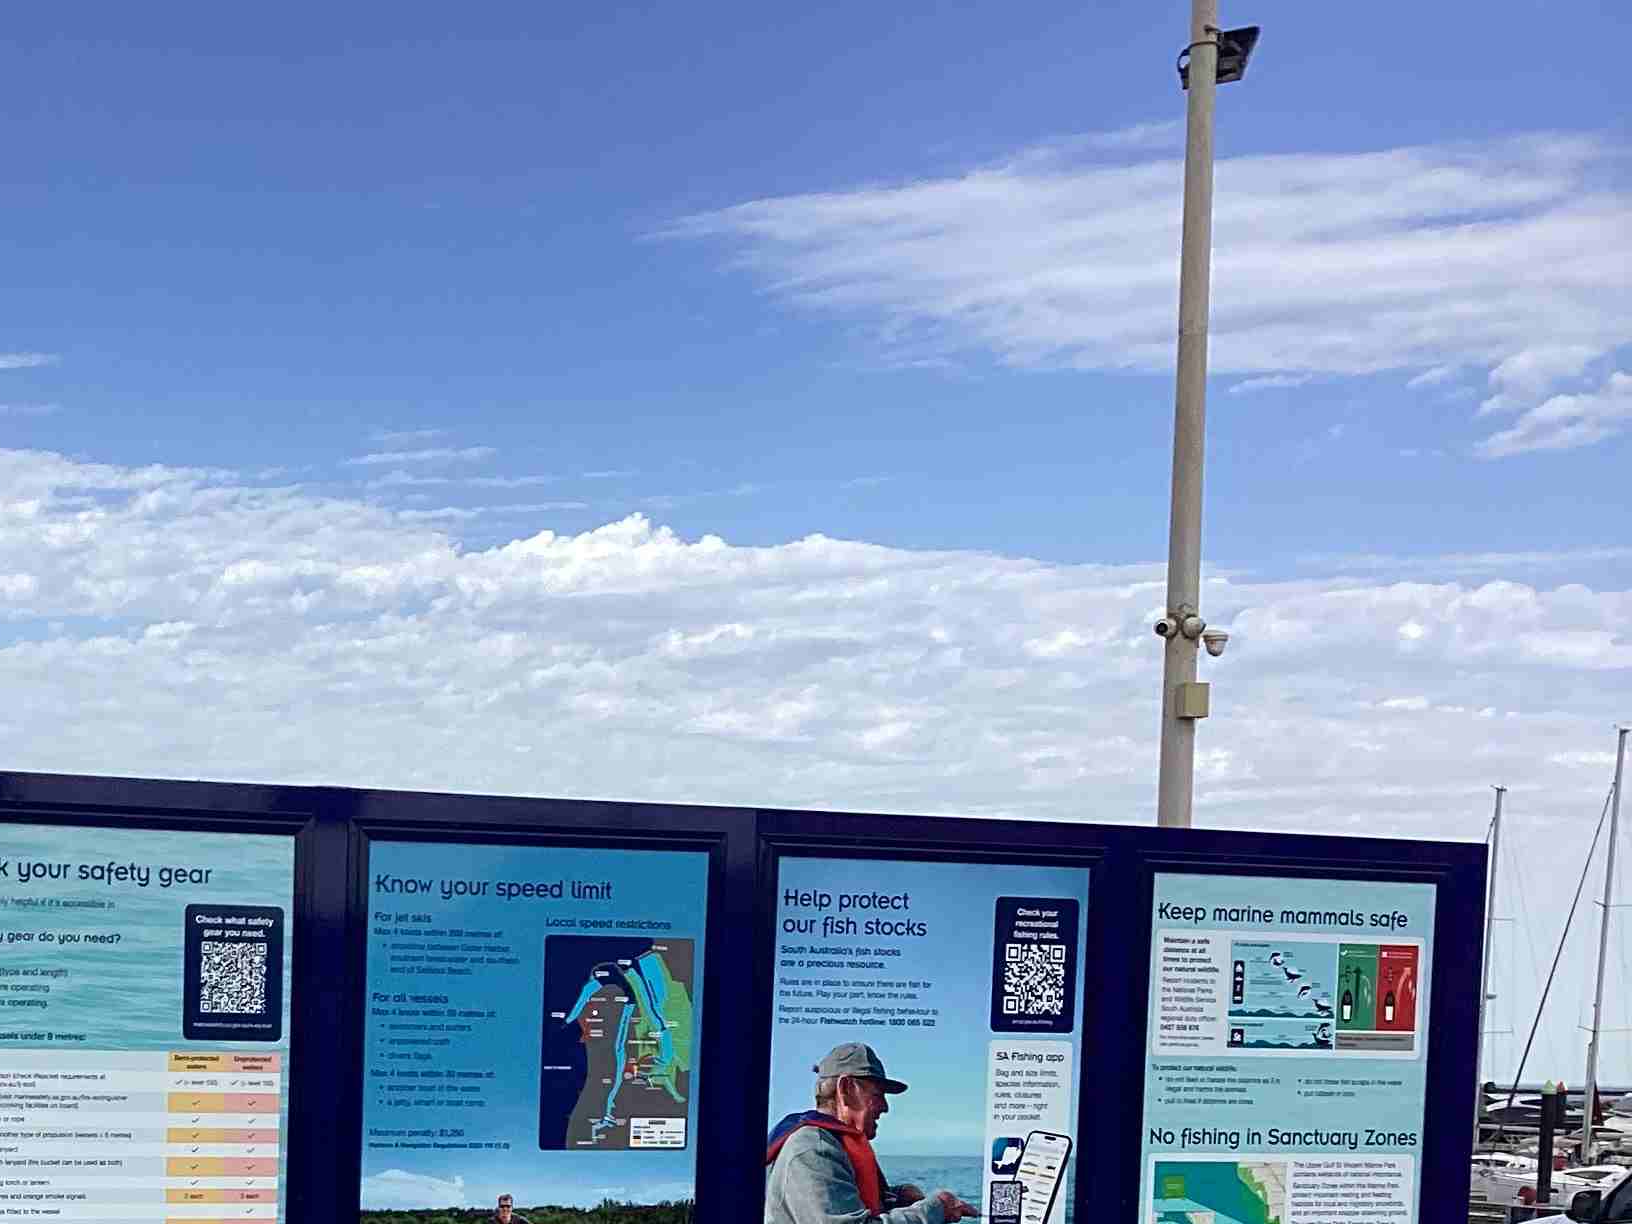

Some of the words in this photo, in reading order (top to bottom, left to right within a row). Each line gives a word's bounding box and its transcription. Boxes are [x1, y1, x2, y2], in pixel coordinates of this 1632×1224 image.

[17, 862, 70, 882] your
[78, 861, 149, 887] safety
[158, 867, 211, 888] gear
[375, 874, 432, 893] Know
[440, 879, 488, 900] your
[496, 879, 563, 900] speed
[571, 880, 611, 899] limit
[784, 888, 831, 911] Help
[838, 891, 908, 912] protect
[783, 918, 816, 933] our
[822, 916, 856, 937] fish
[864, 917, 926, 936] stocks
[1158, 902, 1206, 924] Keep
[1212, 905, 1273, 922] marine
[1280, 909, 1363, 926] mammals
[1370, 910, 1407, 931] safe
[7, 929, 34, 943] gear
[38, 930, 54, 942] do
[57, 934, 80, 944] you
[83, 933, 120, 943] need?
[780, 945, 806, 954] South
[808, 945, 853, 955] Australia's
[855, 947, 871, 957] fish
[873, 947, 901, 956] stocks
[996, 1051, 1009, 1060] SA
[1011, 1051, 1043, 1063] Fishing
[1045, 1054, 1064, 1062] app
[1150, 1127, 1174, 1144] No
[1181, 1127, 1239, 1149] fishing
[1246, 1127, 1261, 1144] in
[1268, 1128, 1357, 1149] Sanctuary
[1364, 1129, 1416, 1145] Zones
